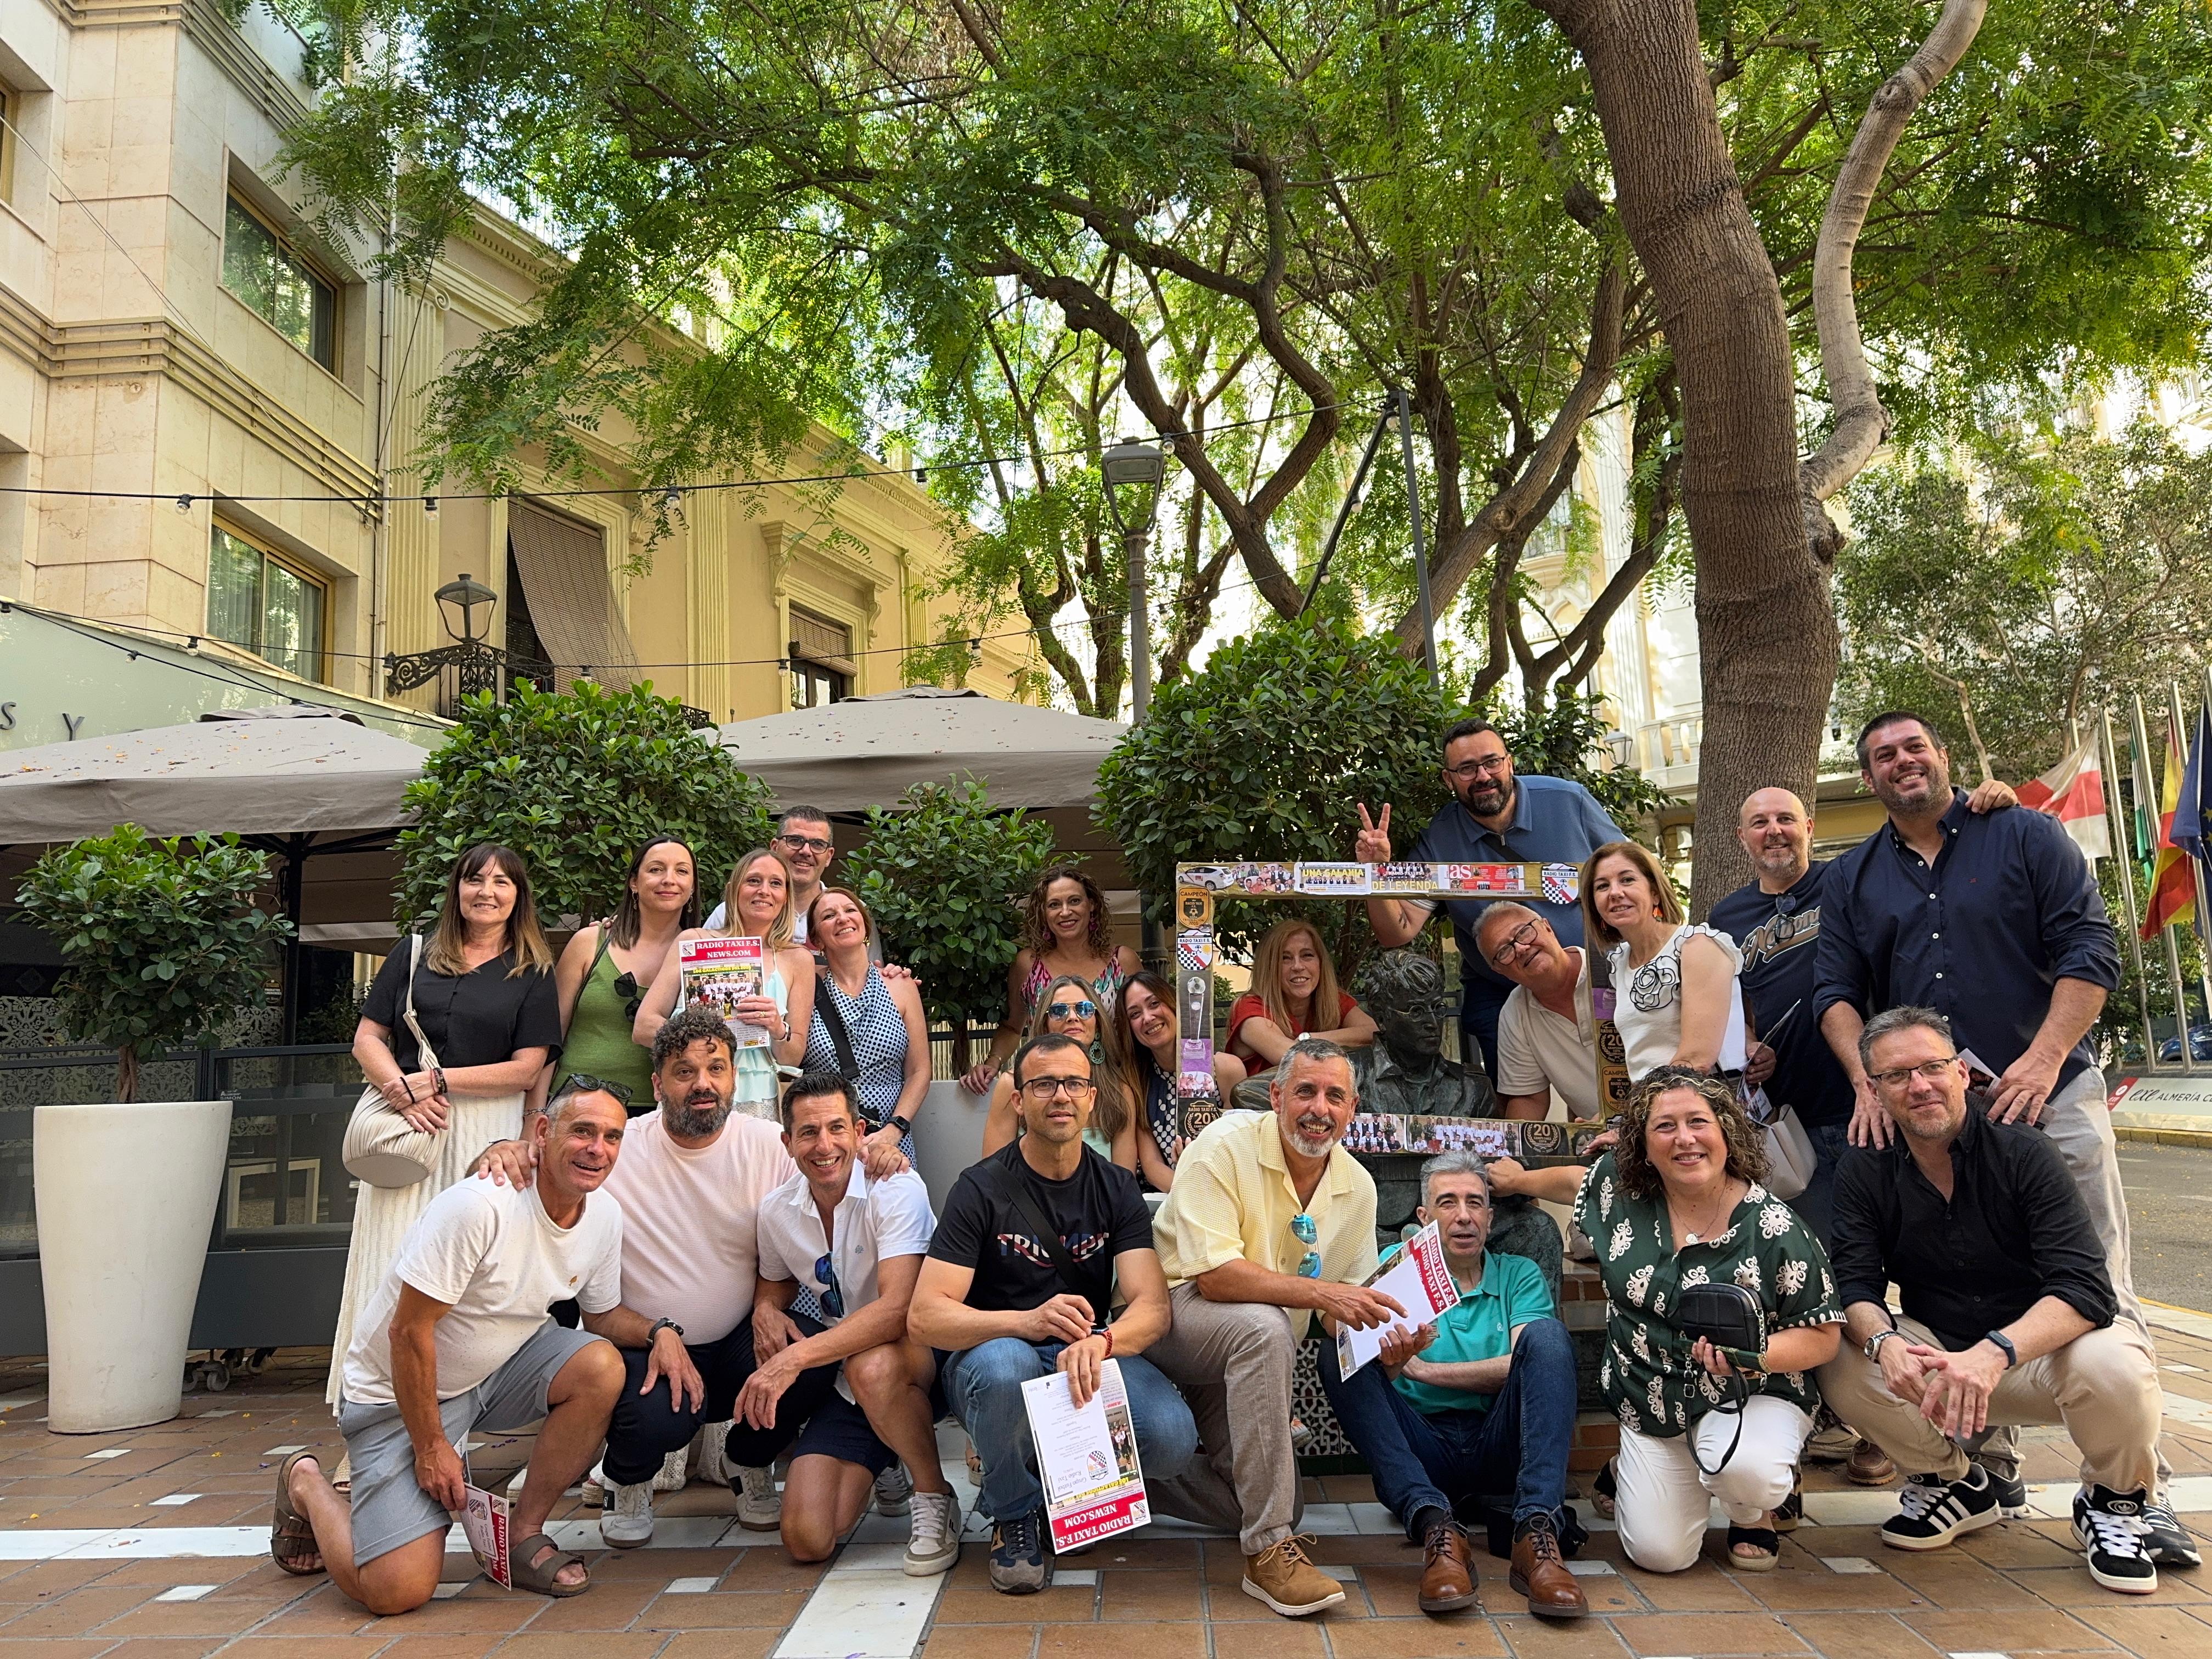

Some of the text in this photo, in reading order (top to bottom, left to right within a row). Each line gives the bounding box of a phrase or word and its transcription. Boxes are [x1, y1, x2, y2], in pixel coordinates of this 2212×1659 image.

[1449, 865, 1471, 879] as
[1372, 881, 1385, 890] DE
[1389, 881, 1437, 890] LEYENDA
[1607, 1034, 1623, 1046] 20
[2155, 1092, 2200, 1102] ALMERÍA
[1194, 1113, 1211, 1124] 20
[1533, 1124, 1550, 1136] 20
[1420, 1242, 1444, 1310] RADIO TAXI F.S.
[1430, 1236, 1454, 1305] RADIO TAXI F.S.
[1058, 1474, 1068, 1483] Taxi
[1068, 1470, 1081, 1479] Radio
[1074, 1477, 1087, 1485] Grupo
[1118, 1477, 1129, 1486] LOS
[1064, 1503, 1117, 1528] NEWS.COM
[1056, 1515, 1131, 1547] RADIO TAXI F.S.
